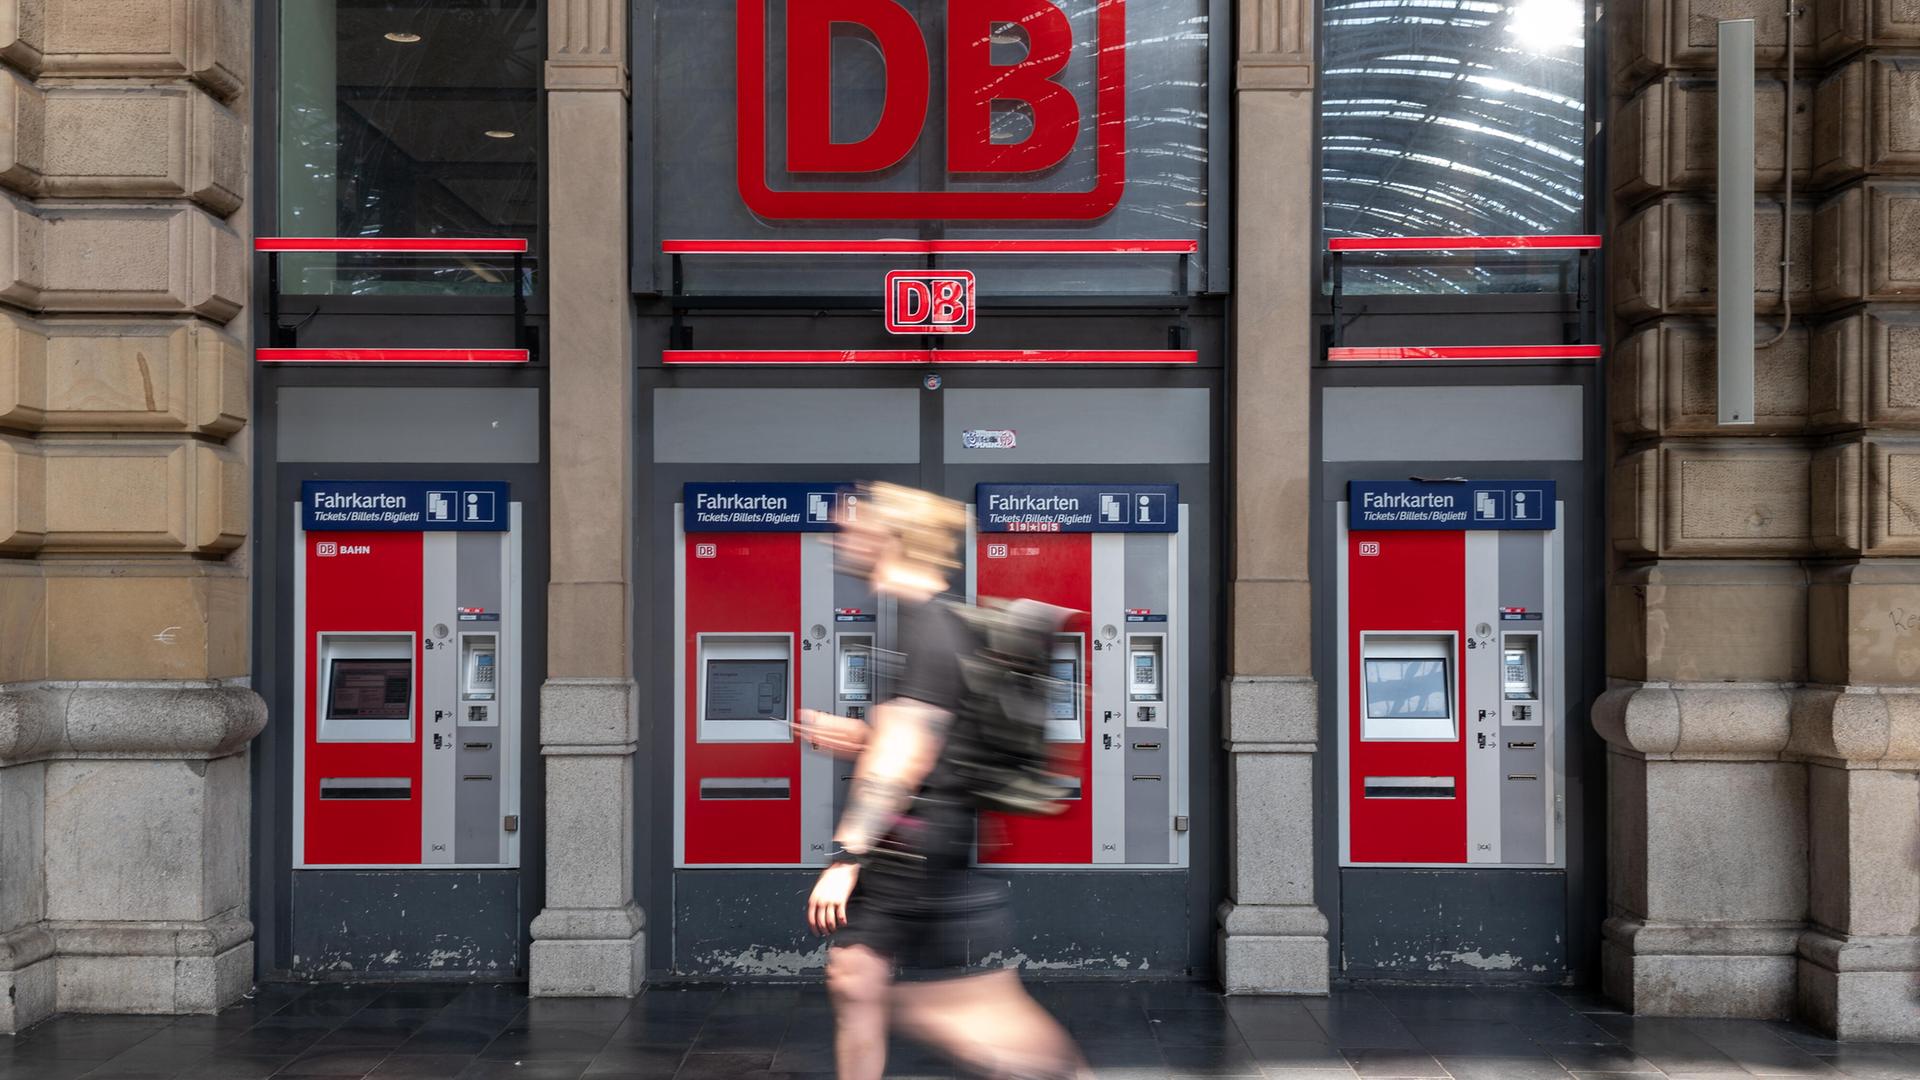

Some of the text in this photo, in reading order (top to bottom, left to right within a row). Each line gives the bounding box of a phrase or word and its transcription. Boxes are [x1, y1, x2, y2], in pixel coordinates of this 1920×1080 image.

[786, 0, 1080, 172] DB
[896, 279, 966, 325] DB
[314, 492, 406, 509] Fahrkarten
[697, 493, 787, 509] Fahrkarten
[989, 494, 1079, 511] Fahrkarten
[1363, 492, 1454, 508] Fahrkarten
[339, 545, 370, 554] BAHN
